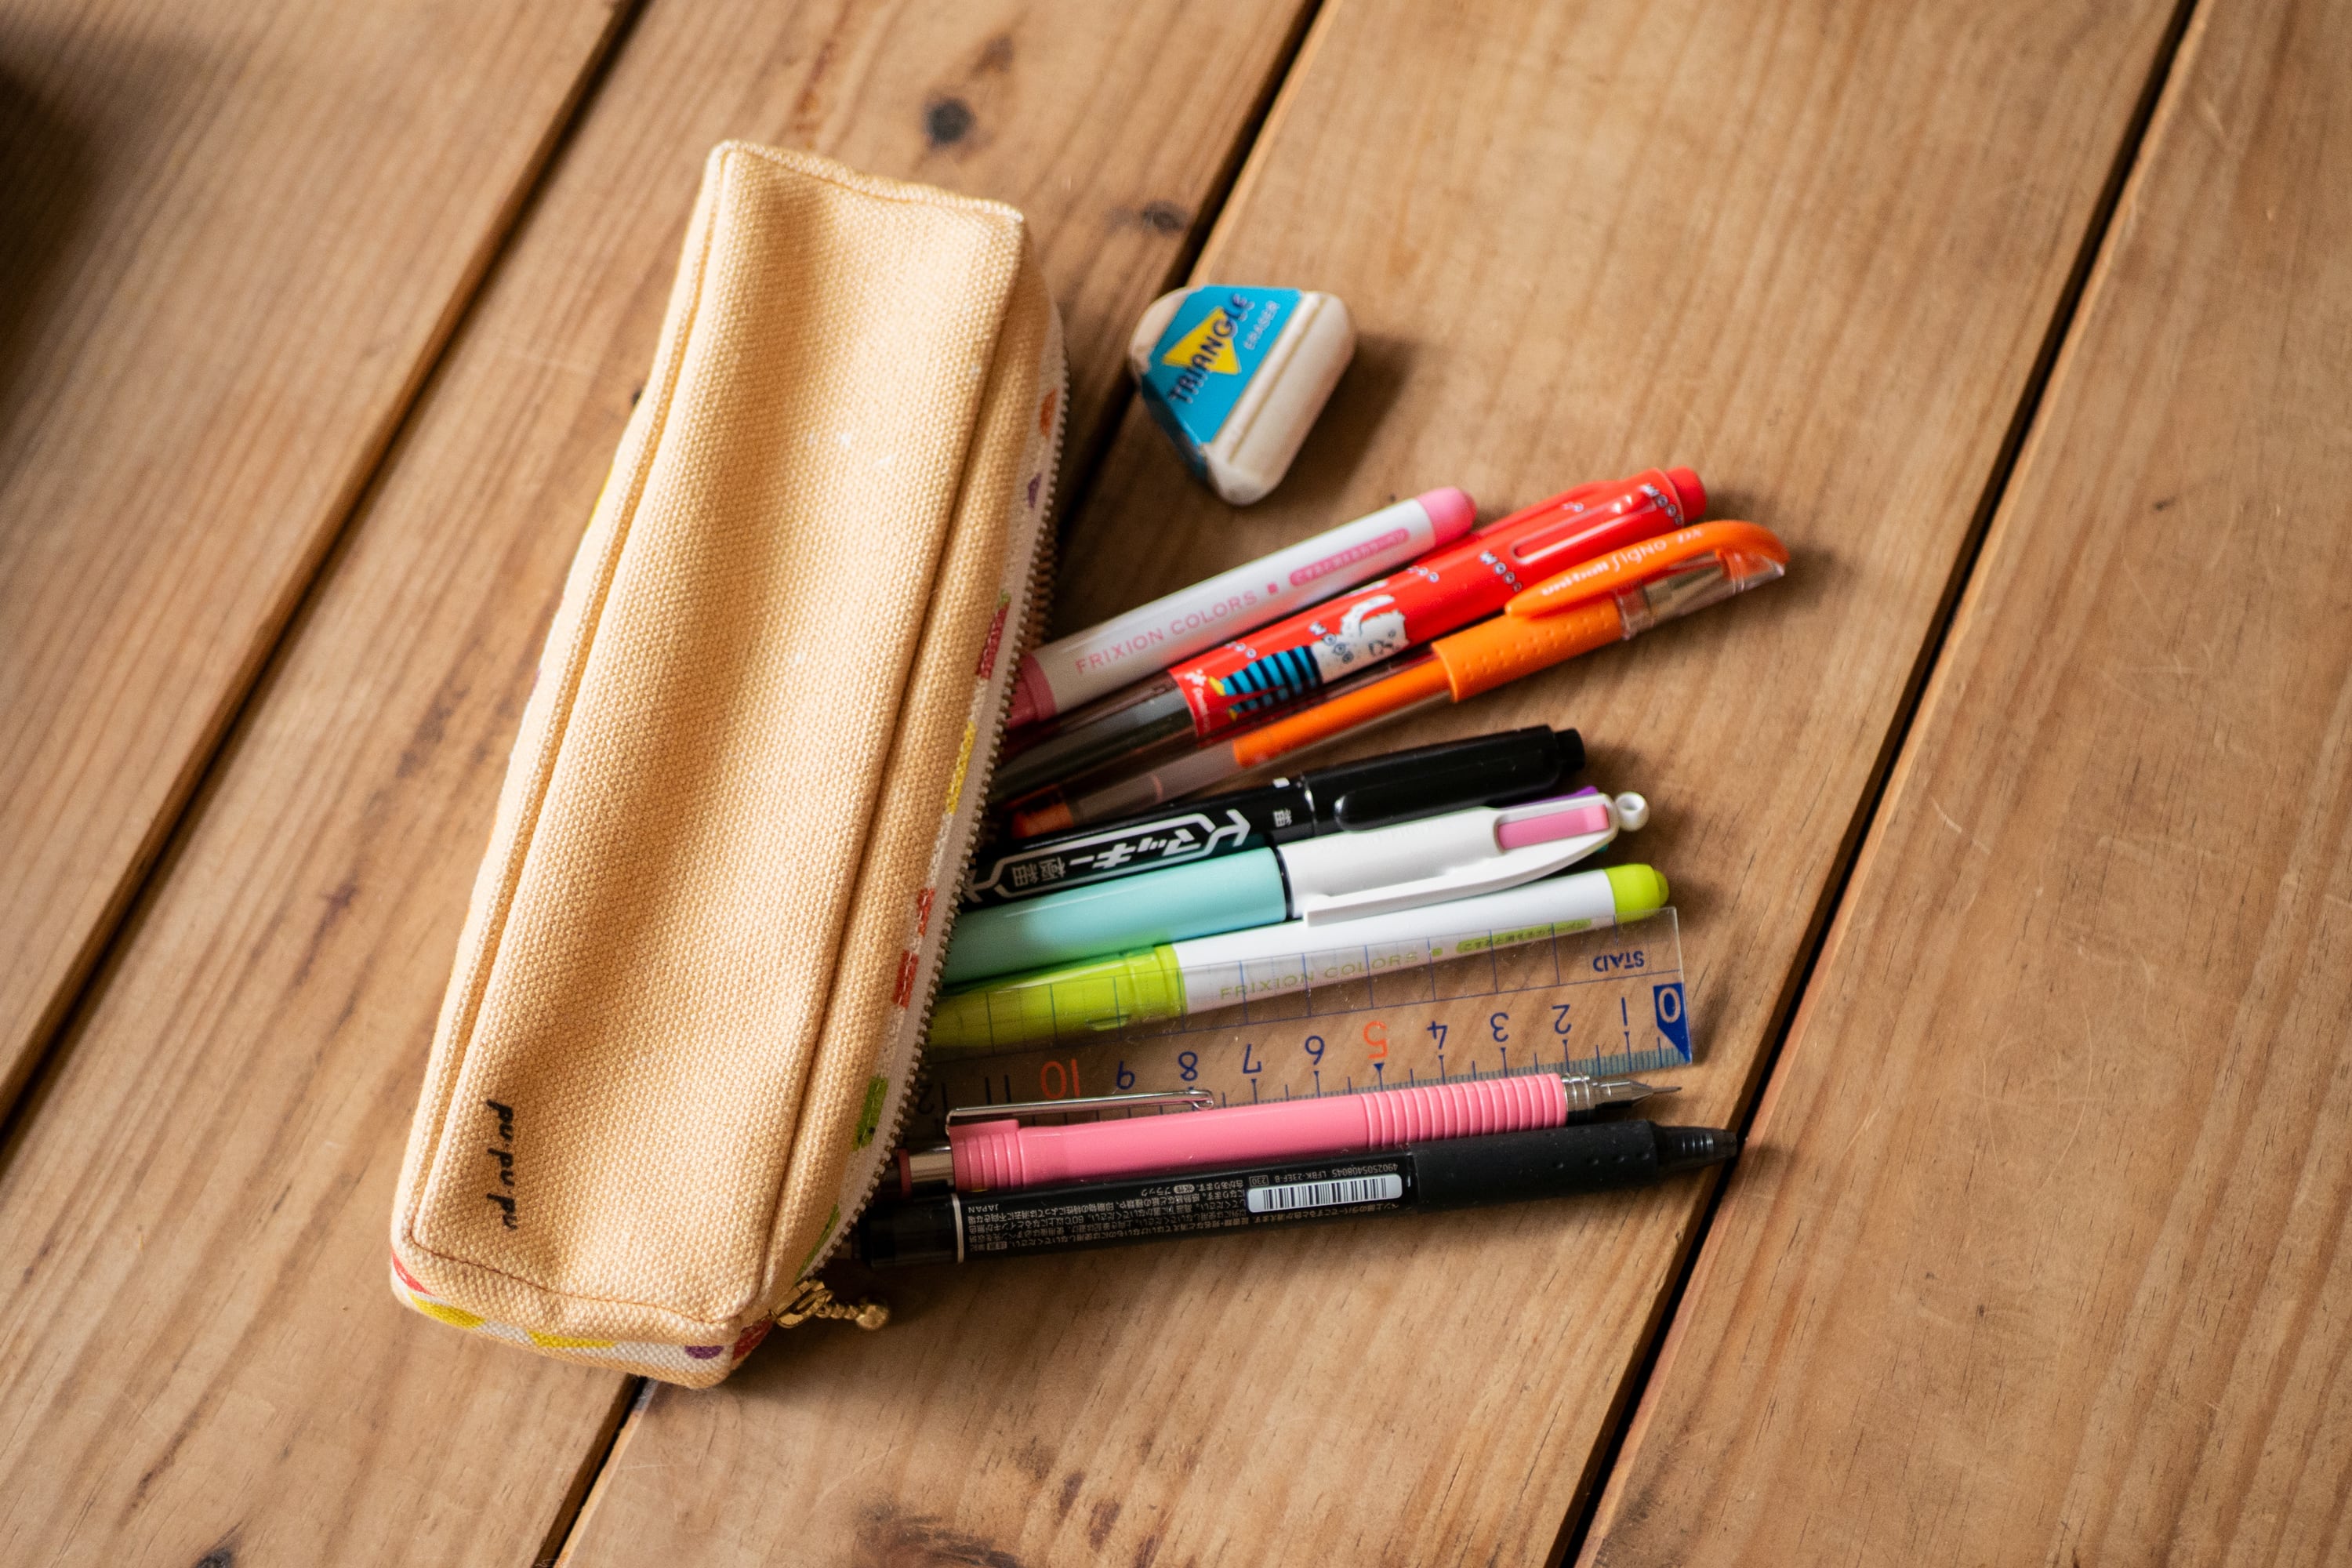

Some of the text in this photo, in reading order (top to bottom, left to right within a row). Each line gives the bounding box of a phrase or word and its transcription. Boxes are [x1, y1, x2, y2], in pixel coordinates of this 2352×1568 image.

[1243, 301, 1280, 350] ERASER
[1168, 293, 1253, 404] TRIANGLE
[1075, 590, 1258, 676] FRIXION COLORS
[1011, 830, 1200, 887] マッキー 極細
[1219, 952, 1418, 1000] FRIXION COLORS
[1552, 1005, 1573, 1035] 2
[1659, 987, 1682, 1024] 0
[1363, 1021, 1388, 1060] 5
[1426, 1021, 1449, 1051] 4
[1490, 1012, 1509, 1043] 3
[1243, 1044, 1263, 1074] 7
[1305, 1036, 1326, 1065] 6
[1040, 1058, 1080, 1098] 10
[1116, 1061, 1136, 1091] 9
[1178, 1051, 1200, 1081] 8
[1251, 1177, 1266, 1185] 230
[1330, 1162, 1399, 1178] 4902505408045
[1140, 1186, 1171, 1196] ブラック
[967, 1203, 999, 1213] JAPAN
